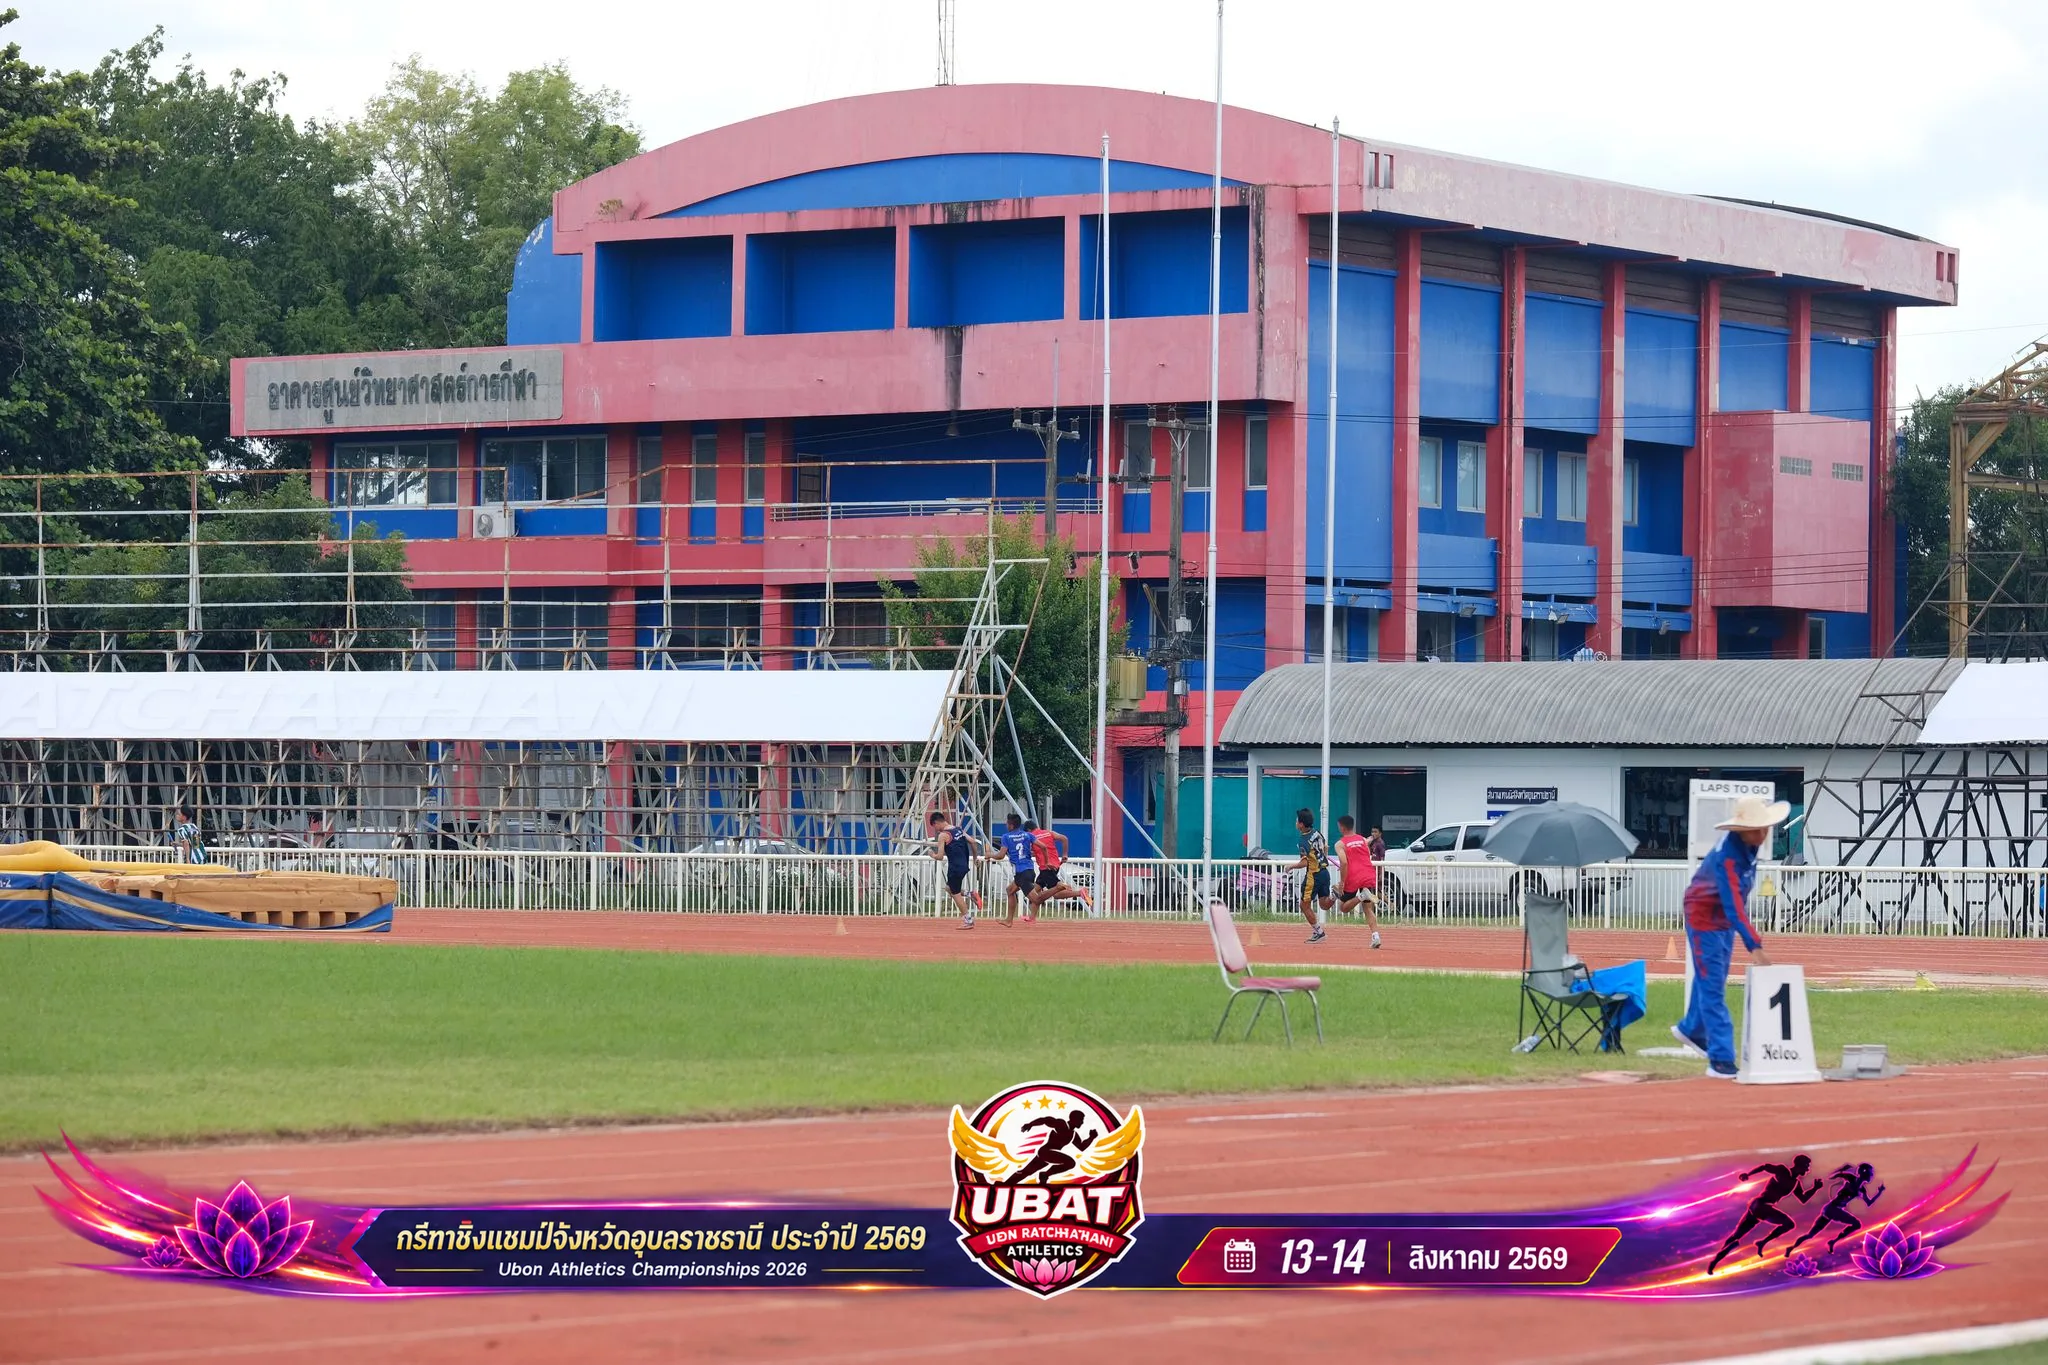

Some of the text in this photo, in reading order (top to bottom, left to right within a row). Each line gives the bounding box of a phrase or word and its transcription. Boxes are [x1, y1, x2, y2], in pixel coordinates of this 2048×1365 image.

[267, 358, 537, 424] อาคารศูนย์วิทยาศาสตร์การกีฬา
[1700, 783, 1770, 795] LAPS TO GO
[1015, 843, 1027, 860] 2
[1769, 983, 1792, 1041] 1
